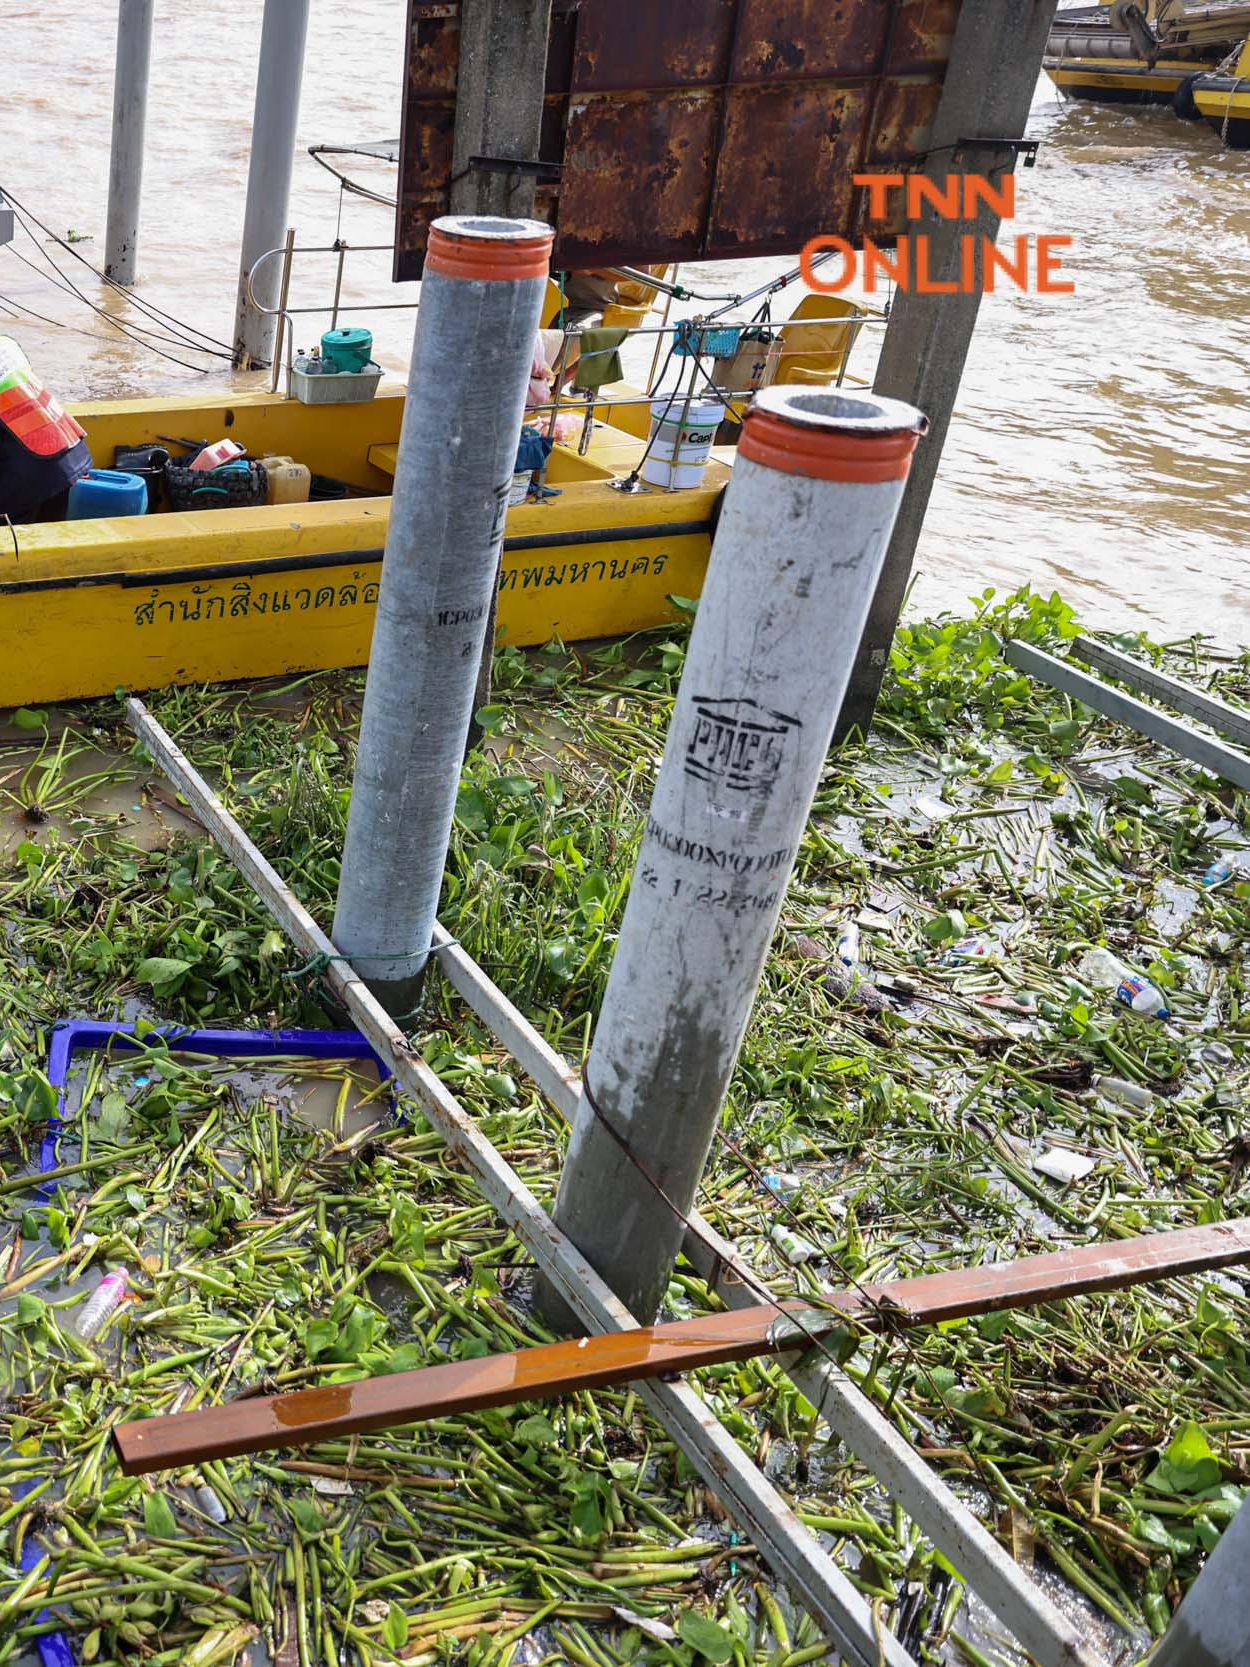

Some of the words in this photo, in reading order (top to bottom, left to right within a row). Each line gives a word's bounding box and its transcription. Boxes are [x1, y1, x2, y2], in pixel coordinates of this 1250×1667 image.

[134, 571, 381, 626] สำนักสิ่งแวดล้อ
[499, 554, 668, 591] ทพมหานคร
